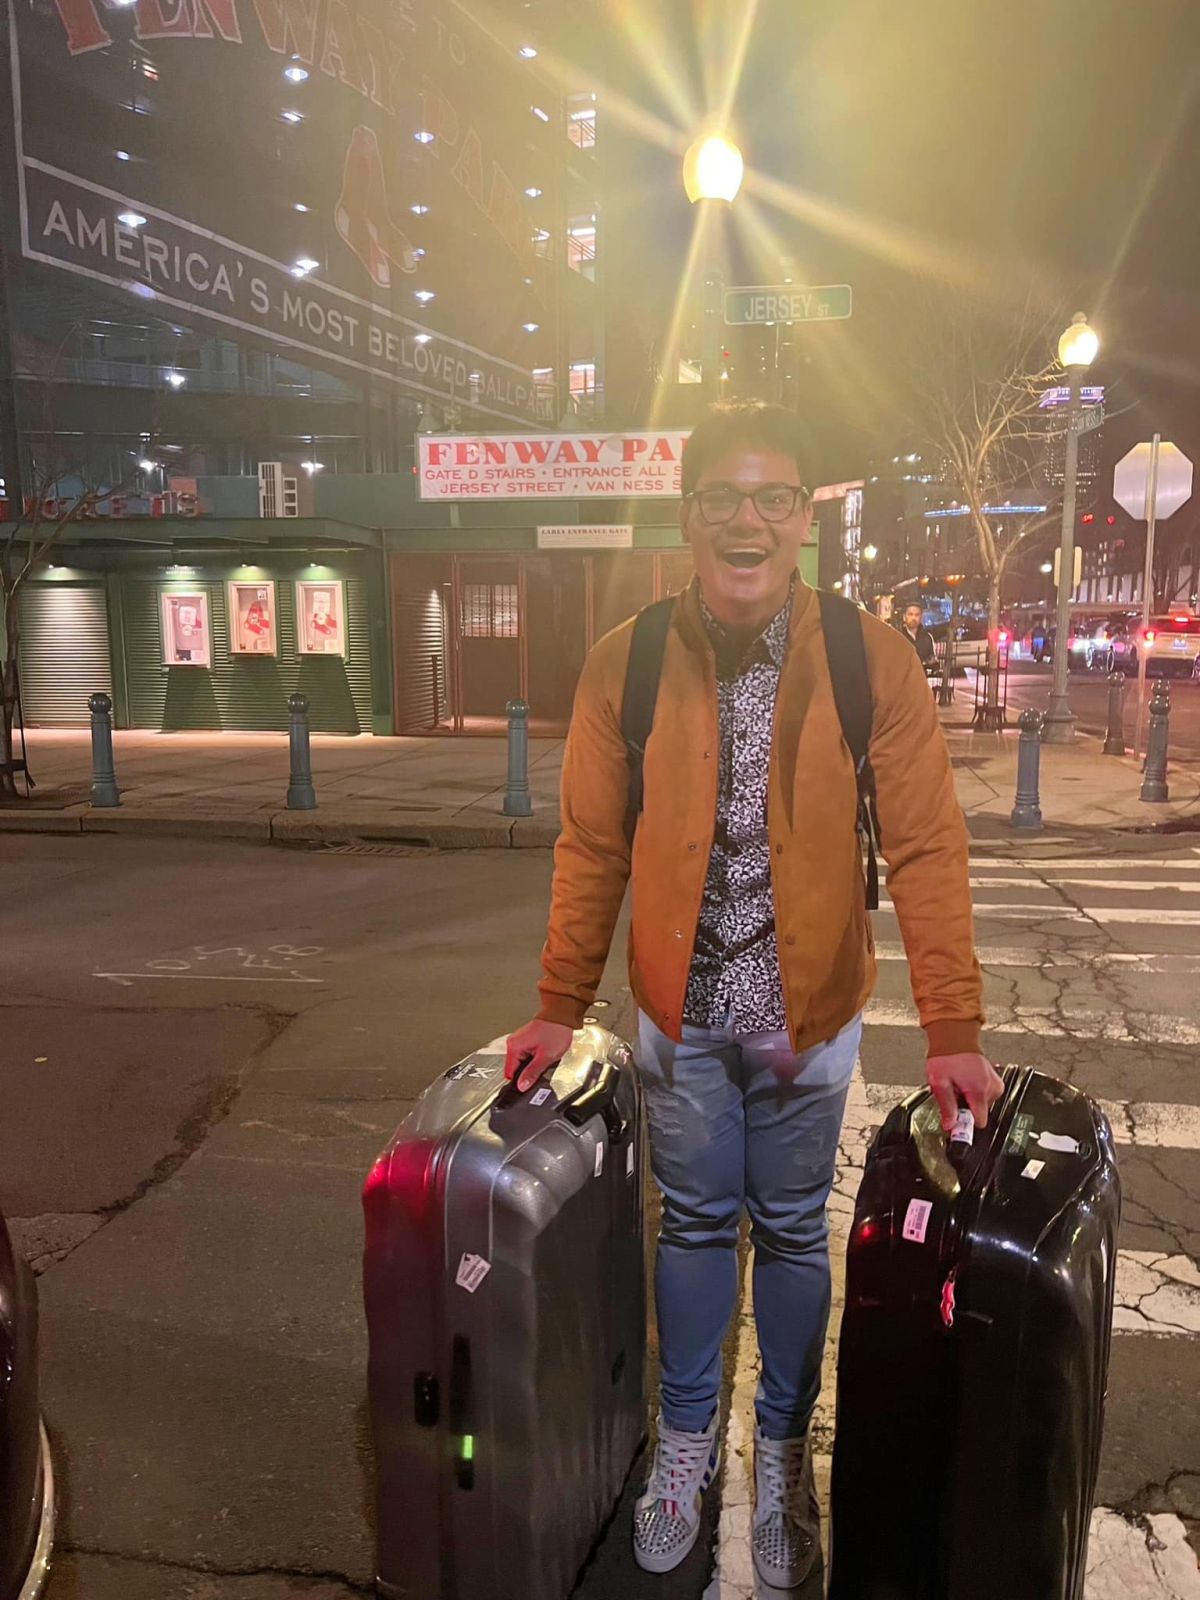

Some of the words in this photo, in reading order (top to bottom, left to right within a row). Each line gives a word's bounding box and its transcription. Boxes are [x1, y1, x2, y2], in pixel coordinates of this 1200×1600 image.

[43, 200, 269, 314] AMERICA'S
[283, 290, 359, 346] MOST
[369, 326, 466, 385] BELOVED
[474, 371, 554, 418] BALLPARK
[744, 294, 813, 321] JERSEY
[817, 303, 830, 317] ST
[426, 439, 607, 466] FENWAY
[425, 469, 462, 480] GATE
[468, 469, 479, 480] D
[486, 468, 535, 480] STAIRS
[553, 466, 632, 478] ENTRANCE
[638, 466, 666, 476] ALL
[440, 483, 500, 494] JERSEY
[507, 481, 565, 493] STREET
[586, 481, 614, 491] VAN
[623, 480, 664, 490] NESS
